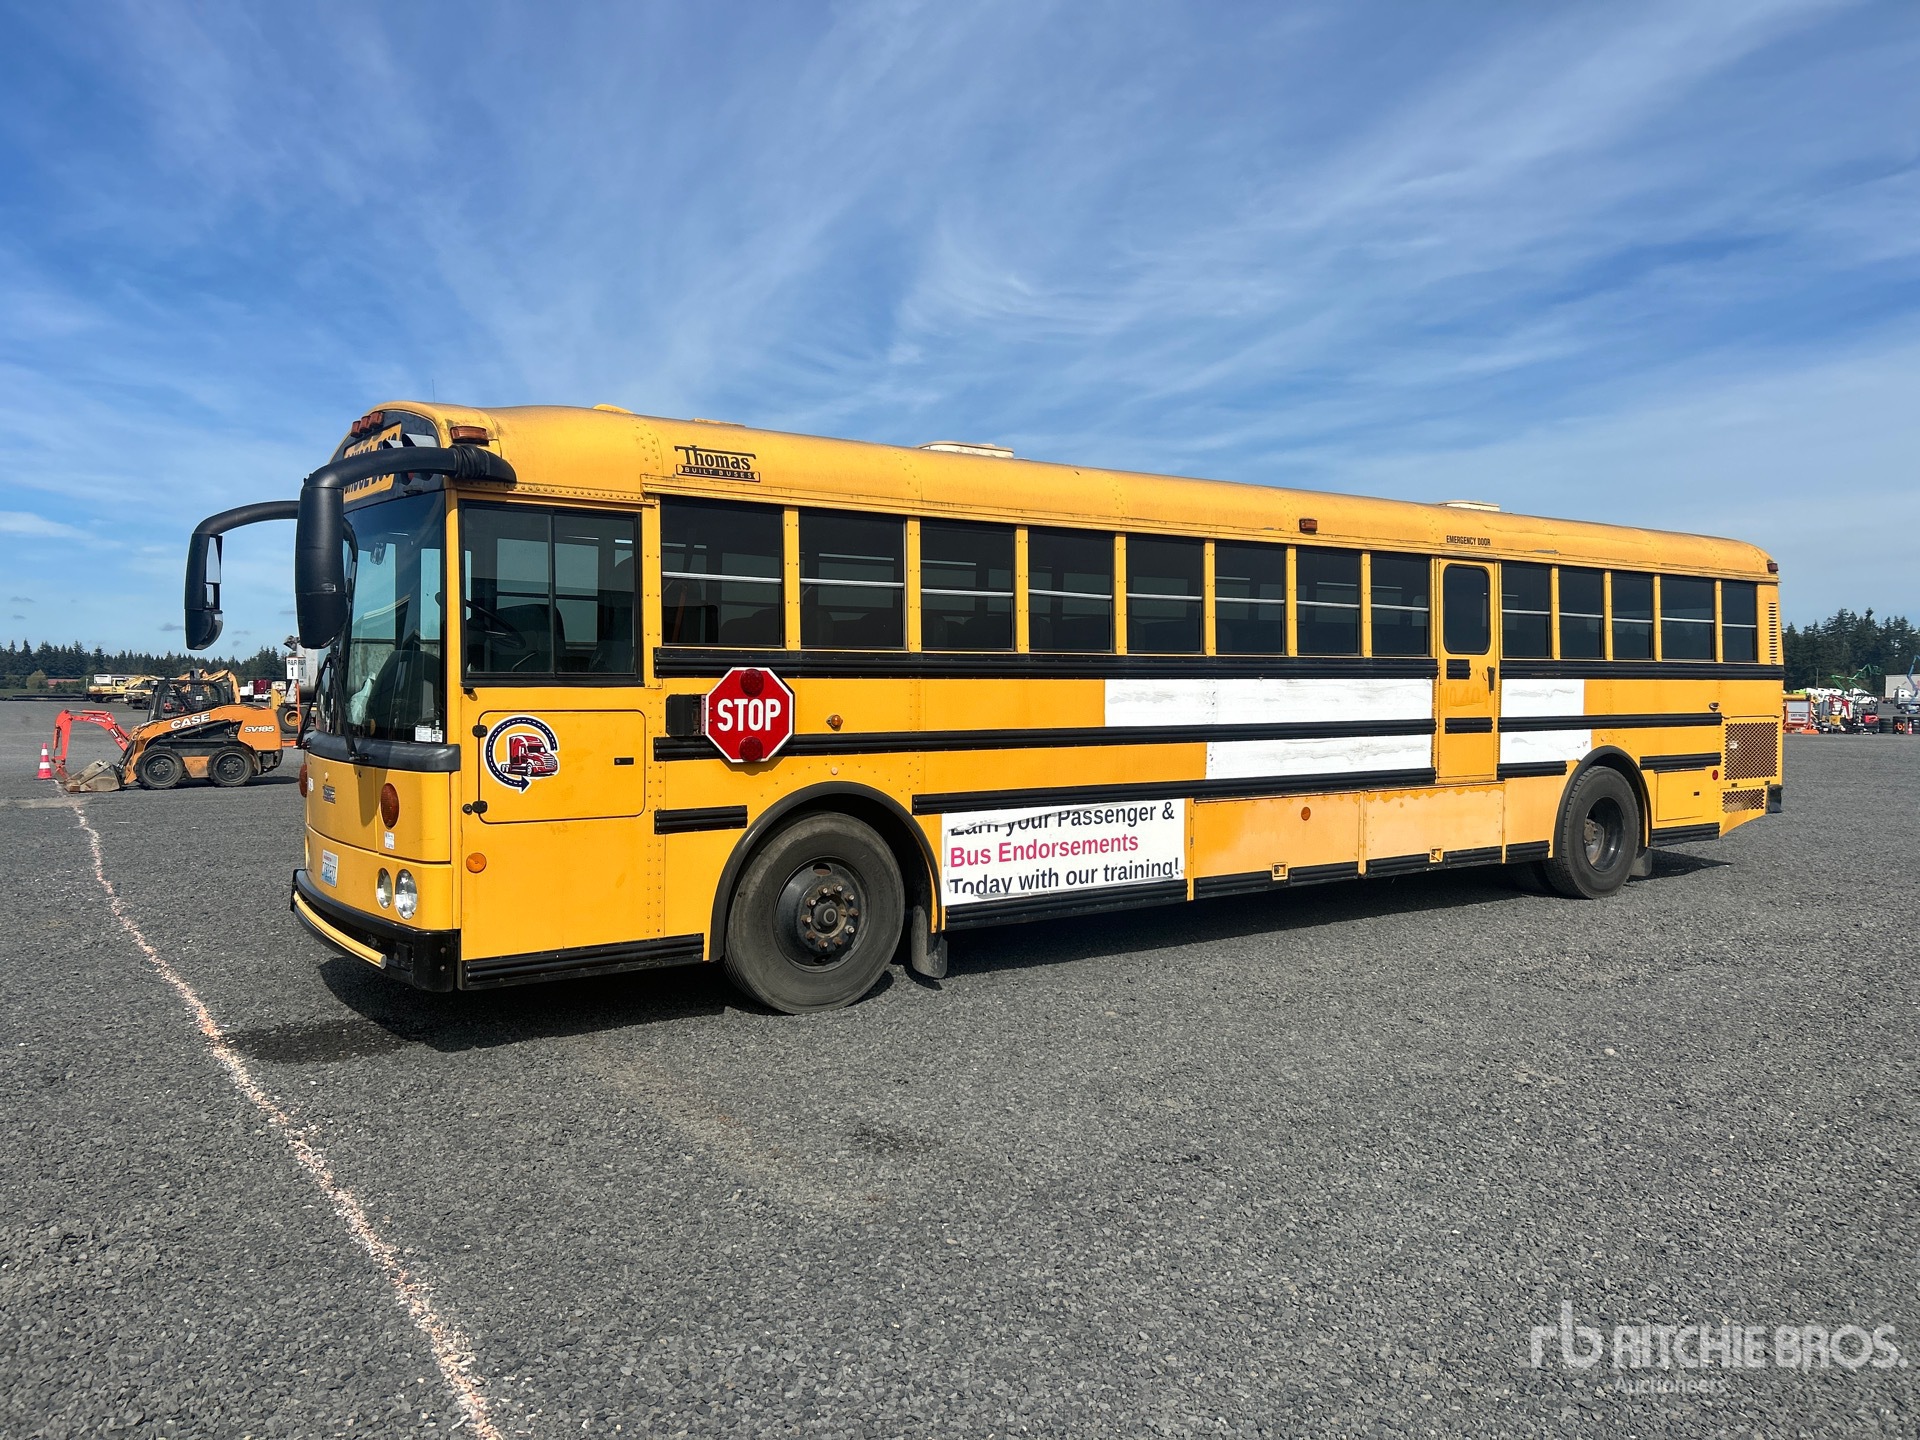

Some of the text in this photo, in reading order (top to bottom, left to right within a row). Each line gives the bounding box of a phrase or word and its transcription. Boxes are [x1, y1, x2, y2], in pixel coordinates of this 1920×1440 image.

[674, 445, 756, 471] Thomas
[684, 466, 752, 479] BUILT BUSES
[1446, 535, 1491, 546] EMERGENCY DOOR
[170, 712, 211, 730] CASE
[717, 698, 781, 732] STOP
[244, 725, 275, 733] SV185
[1006, 813, 1052, 837] your
[1057, 806, 1157, 828] Passenger
[1162, 801, 1175, 820] &
[950, 833, 1139, 868] Bus Endorsements
[949, 857, 1179, 895] Today with our training!
